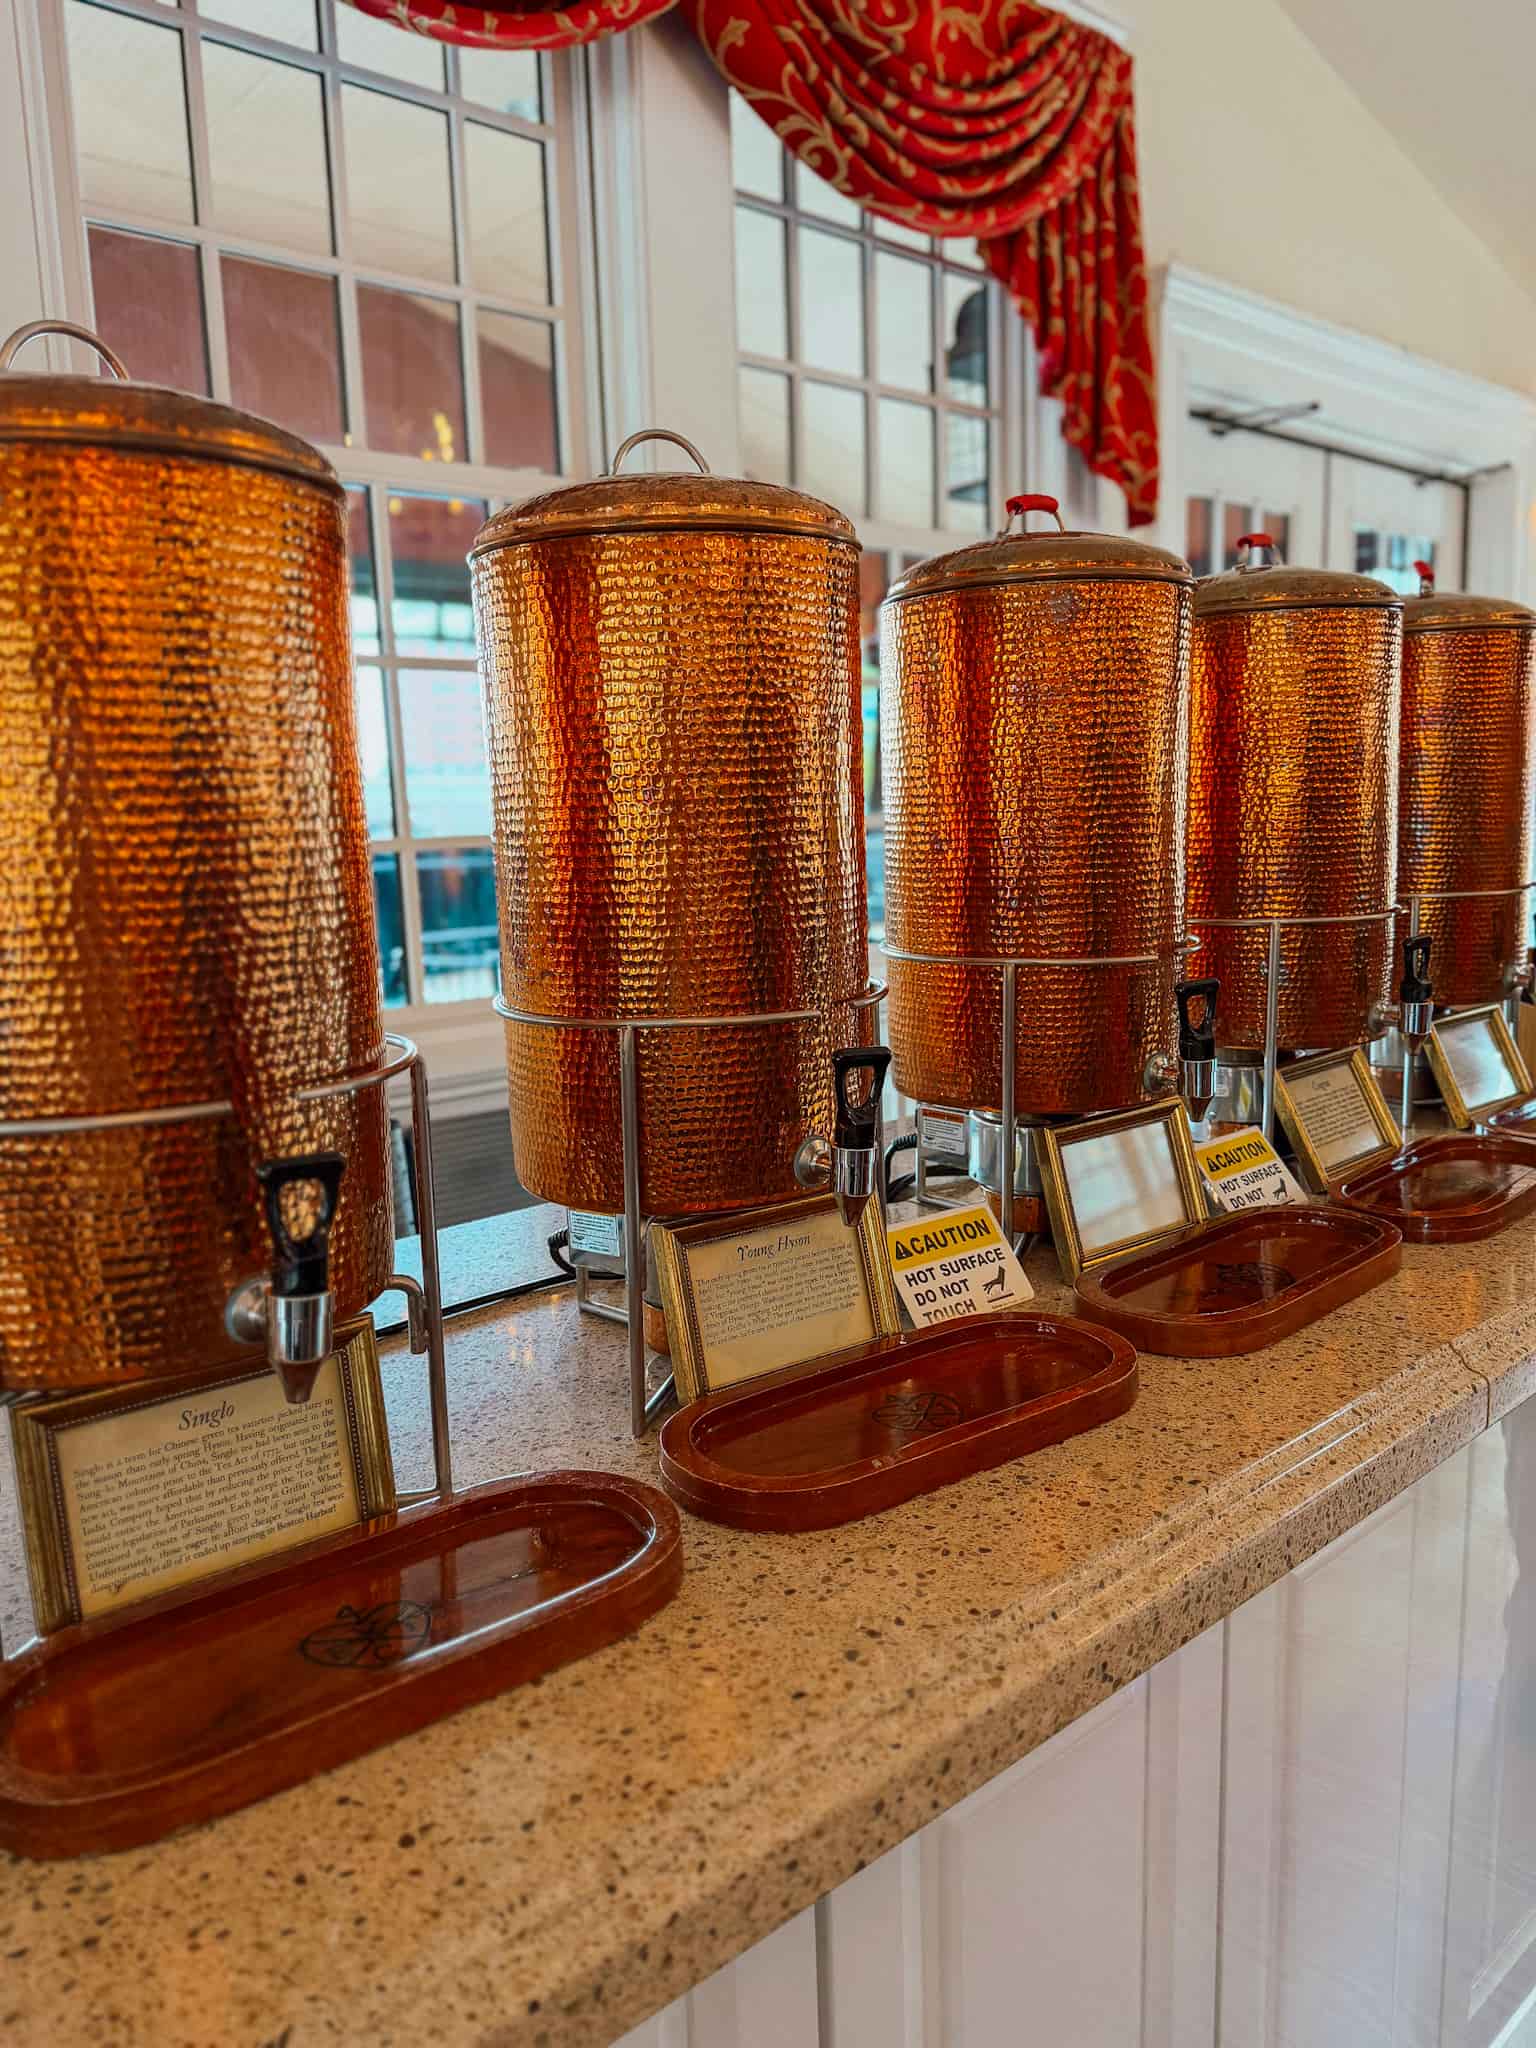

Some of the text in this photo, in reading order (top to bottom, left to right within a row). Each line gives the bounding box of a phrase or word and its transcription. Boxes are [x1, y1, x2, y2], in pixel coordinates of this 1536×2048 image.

[1216, 1140, 1267, 1168] CAUTION
[1220, 1163, 1282, 1194] HOT SURFACE
[1230, 1187, 1265, 1208] DO NOT
[910, 1219, 991, 1254] CAUTION
[737, 1243, 777, 1261] Young
[905, 1247, 1005, 1287] HOT SURFACE
[914, 1278, 970, 1306] DO NOT
[922, 1298, 977, 1324] TOUCH
[179, 1400, 235, 1431] Singlo
